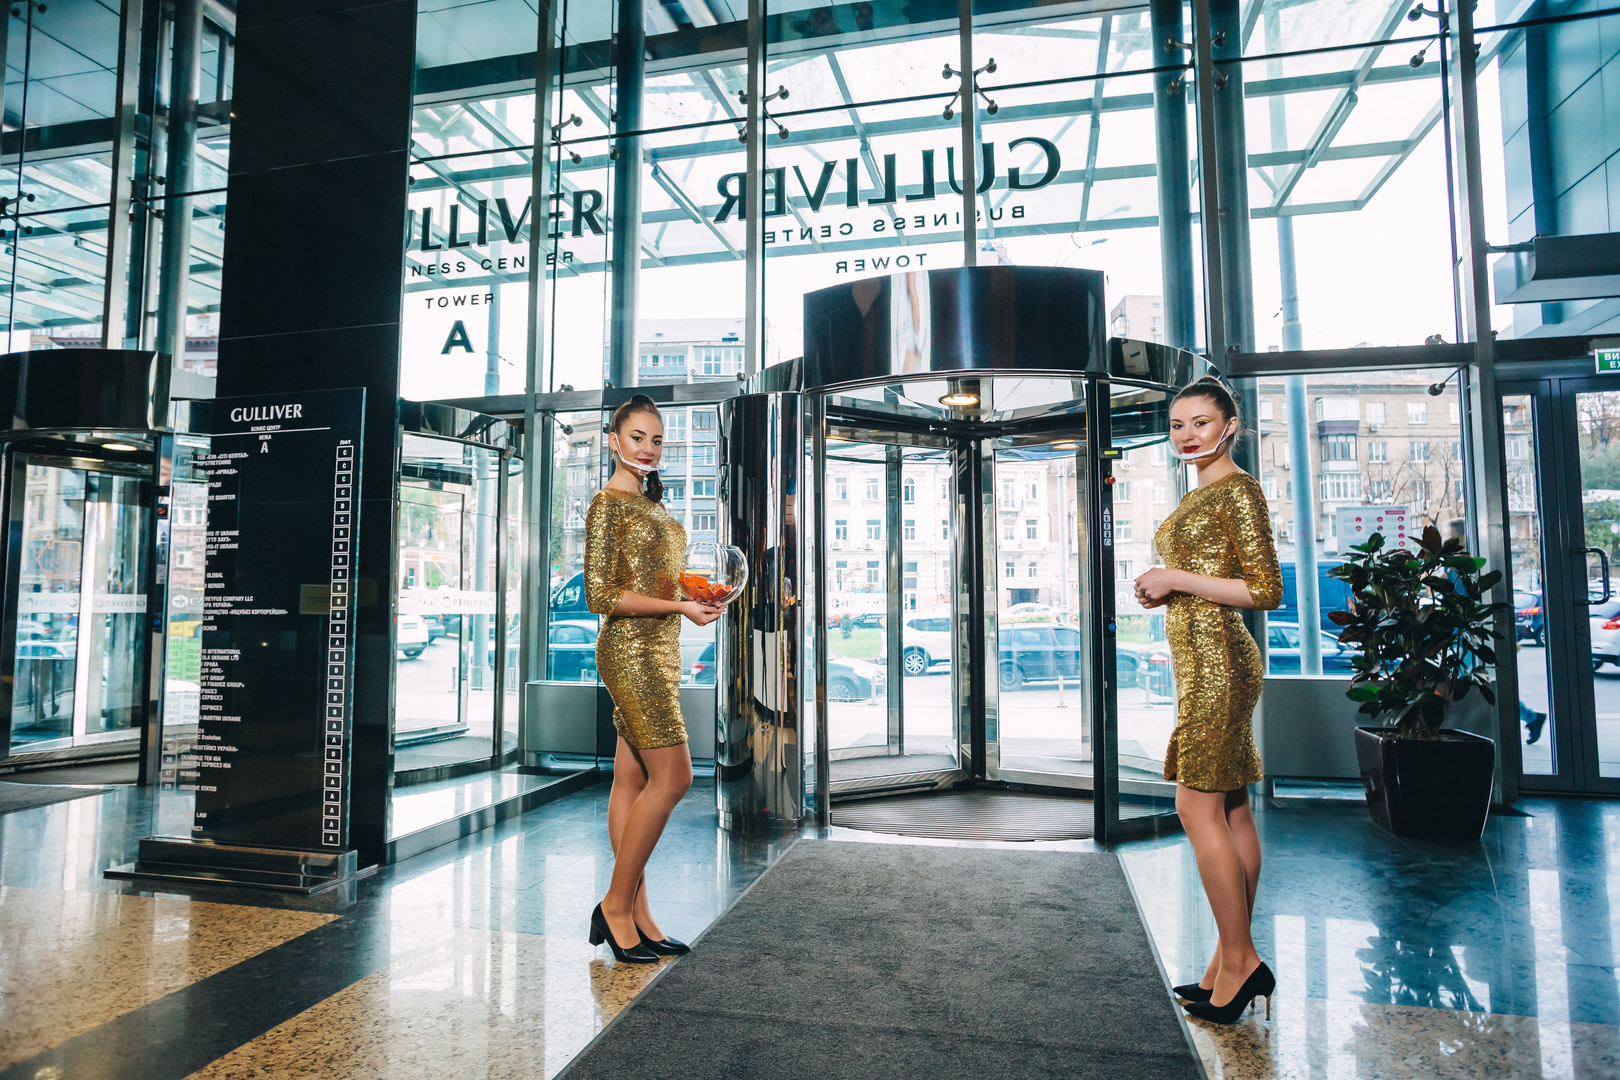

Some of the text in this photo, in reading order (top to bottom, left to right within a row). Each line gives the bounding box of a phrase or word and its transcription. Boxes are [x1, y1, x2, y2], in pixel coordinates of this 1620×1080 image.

[406, 189, 608, 253] LLIVER
[411, 251, 574, 277] NESS CENER
[425, 293, 495, 309] TOWER
[440, 320, 475, 355] A
[230, 403, 303, 423] GULLIVER
[260, 441, 269, 454] A
